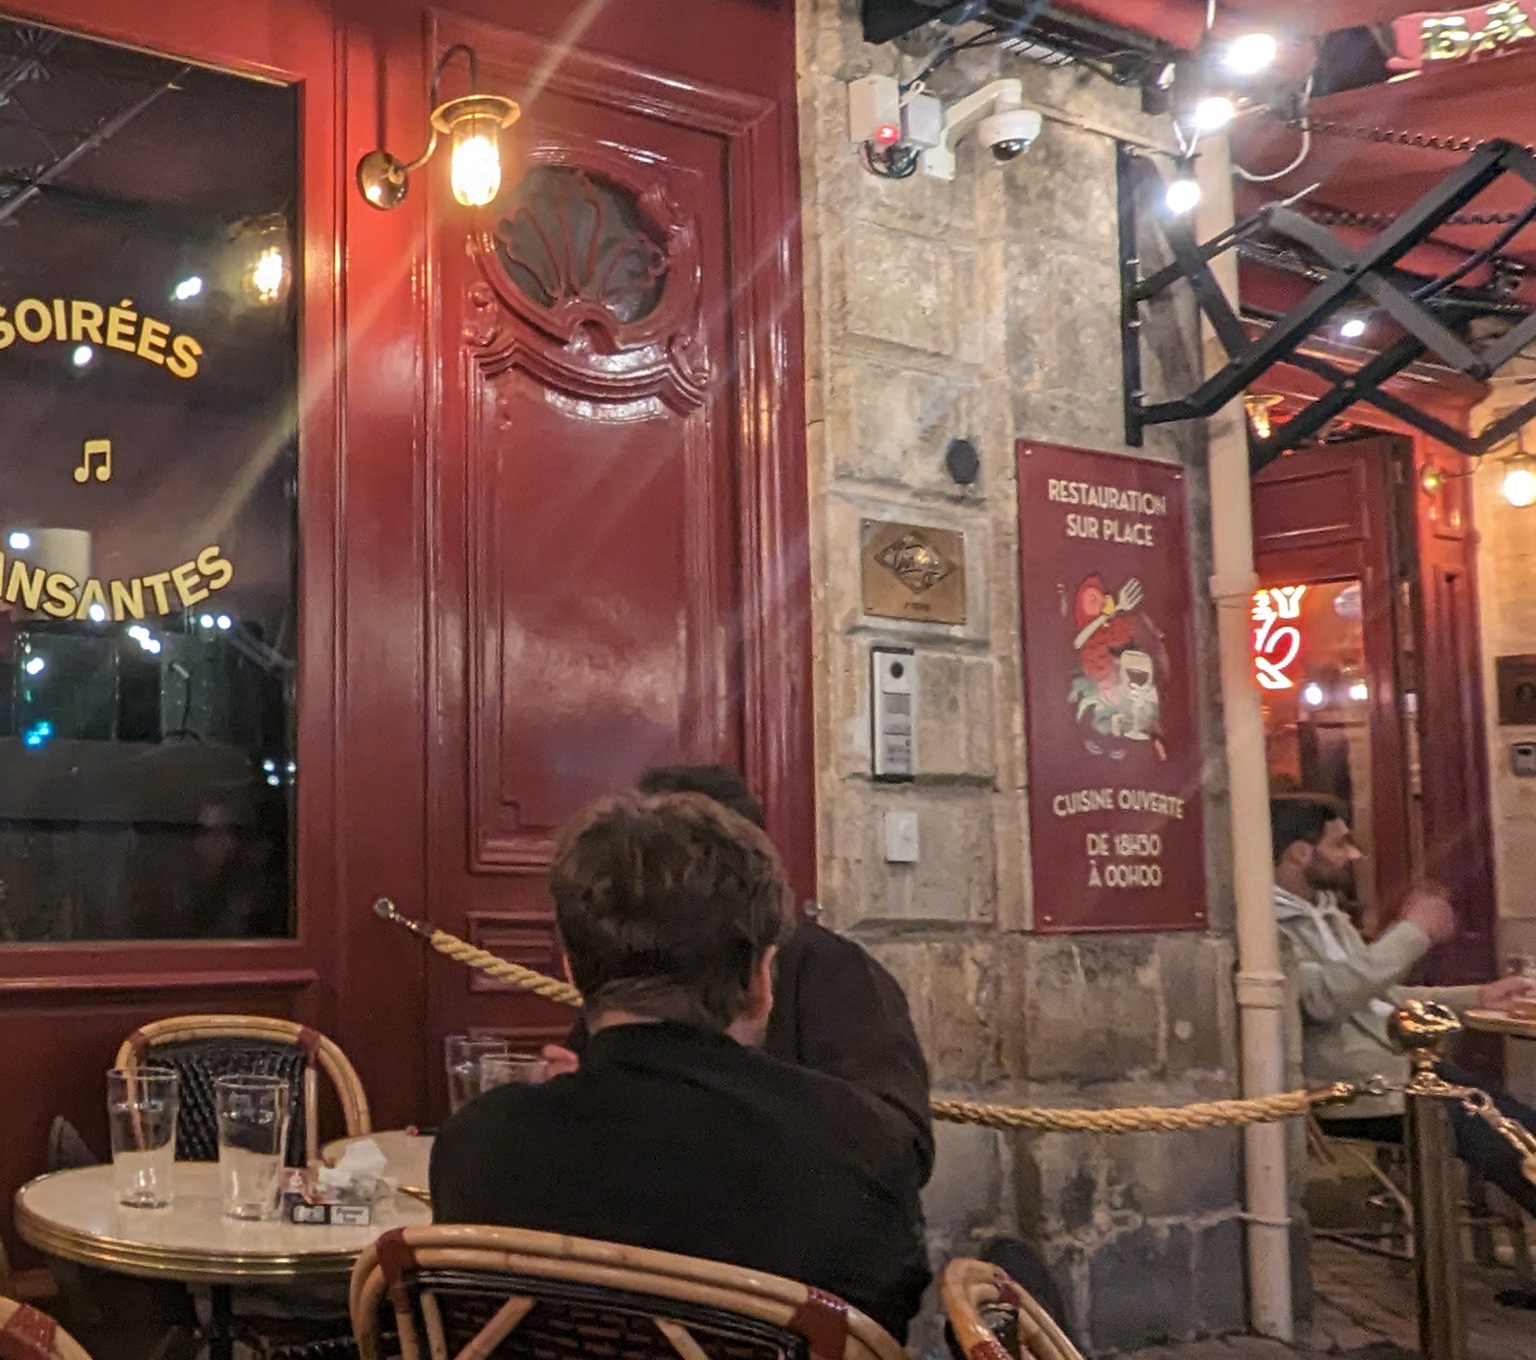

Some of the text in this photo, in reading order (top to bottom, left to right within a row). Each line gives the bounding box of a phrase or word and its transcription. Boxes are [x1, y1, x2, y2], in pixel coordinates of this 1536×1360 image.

[1048, 478, 1167, 516] RESTAURATION
[1066, 513, 1155, 547] SUR PLACE
[1053, 788, 1186, 819] CUISINE OUVERTE
[1086, 833, 1110, 856] DE
[1088, 859, 1163, 888] À 00H00
